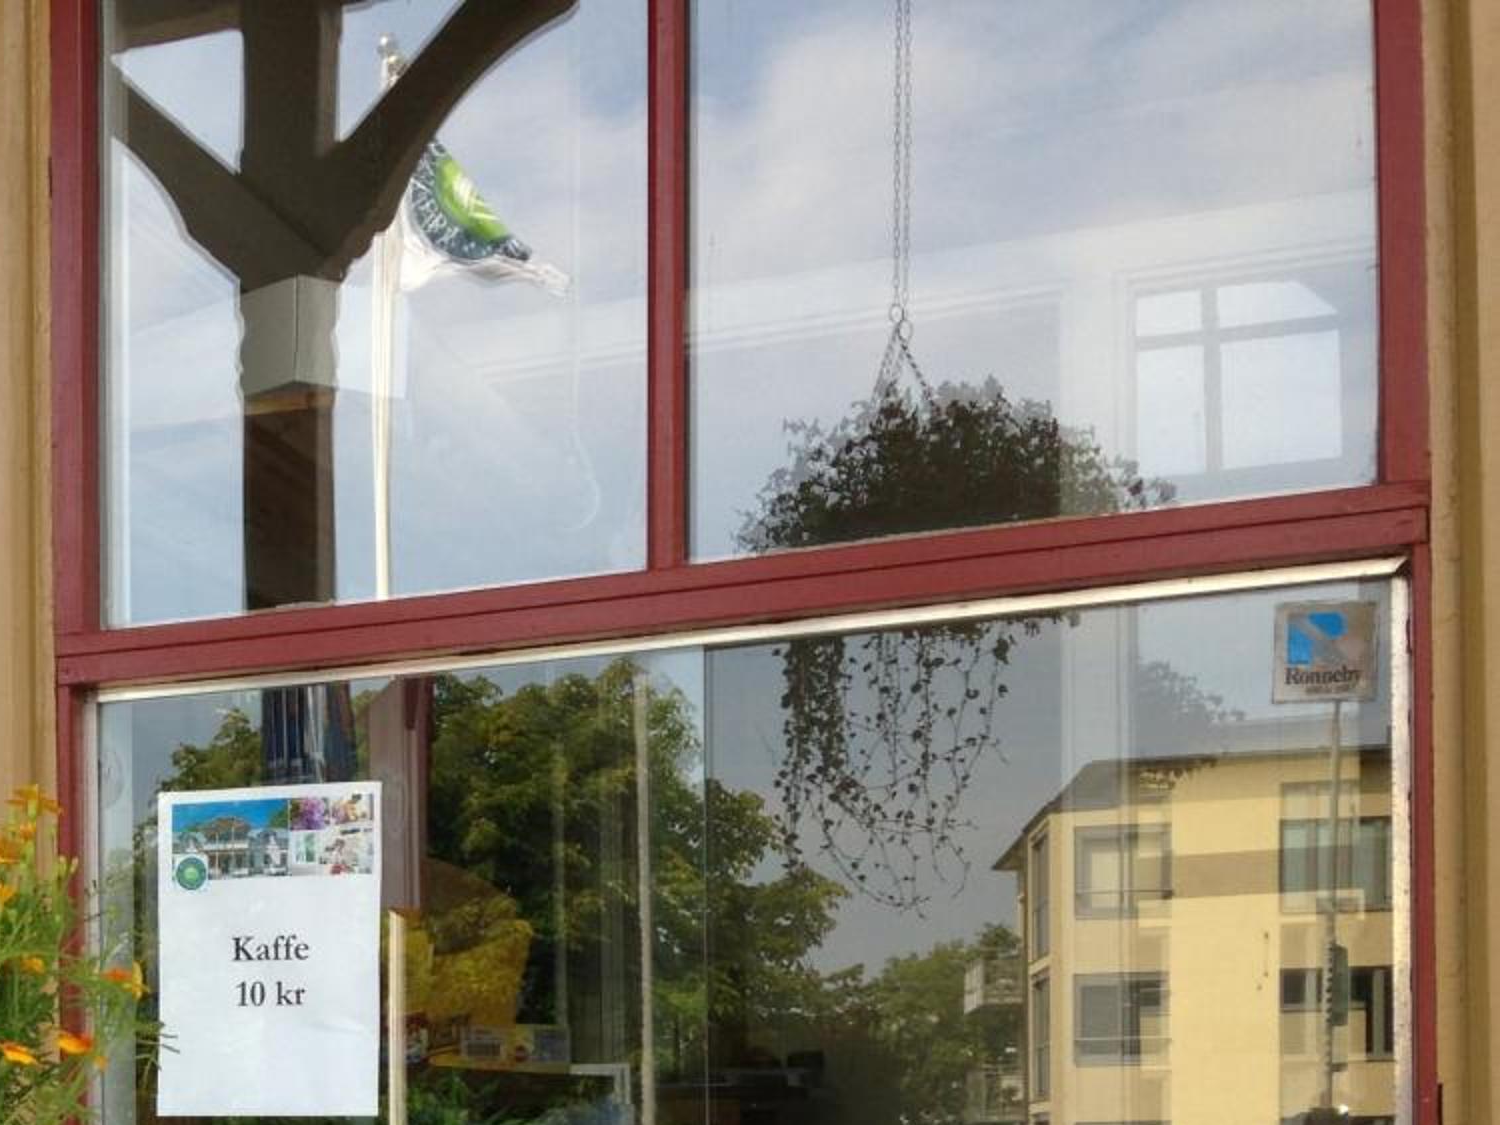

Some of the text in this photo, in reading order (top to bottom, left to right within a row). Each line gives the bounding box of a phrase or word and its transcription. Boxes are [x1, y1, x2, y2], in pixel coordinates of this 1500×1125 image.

[1284, 664, 1362, 687] Ronneby
[232, 934, 309, 961] Kaffe
[236, 981, 305, 1007] 10 kr
